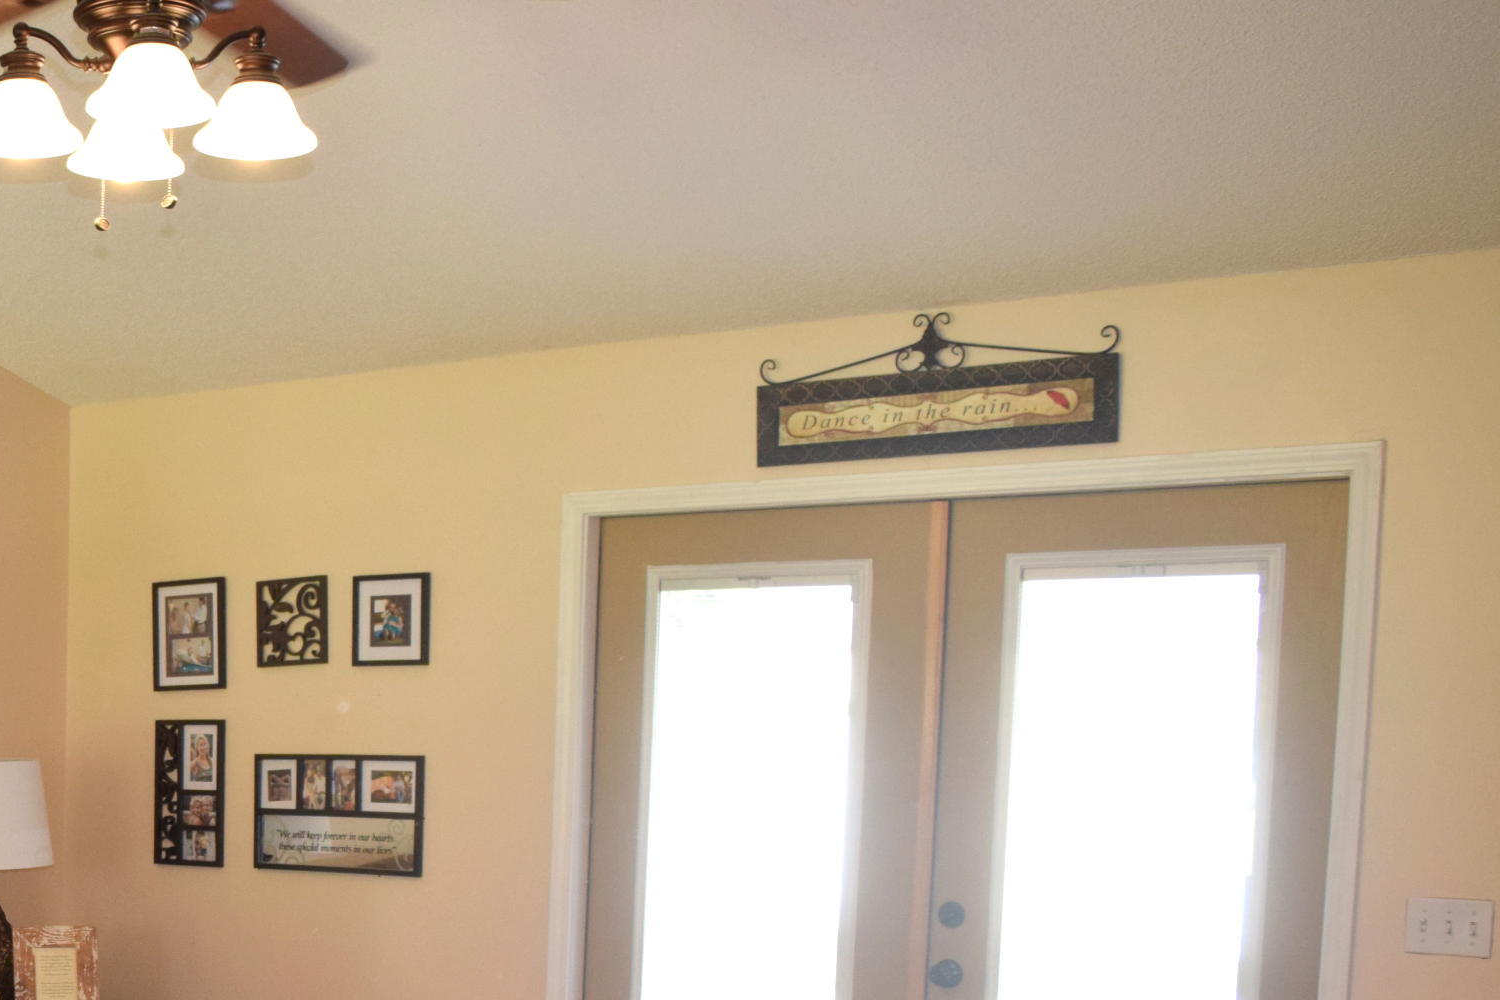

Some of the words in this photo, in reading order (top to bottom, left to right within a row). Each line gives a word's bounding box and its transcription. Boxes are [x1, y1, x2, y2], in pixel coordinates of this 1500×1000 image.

[802, 411, 871, 430] Dance
[883, 407, 904, 423] in
[916, 404, 951, 420] the
